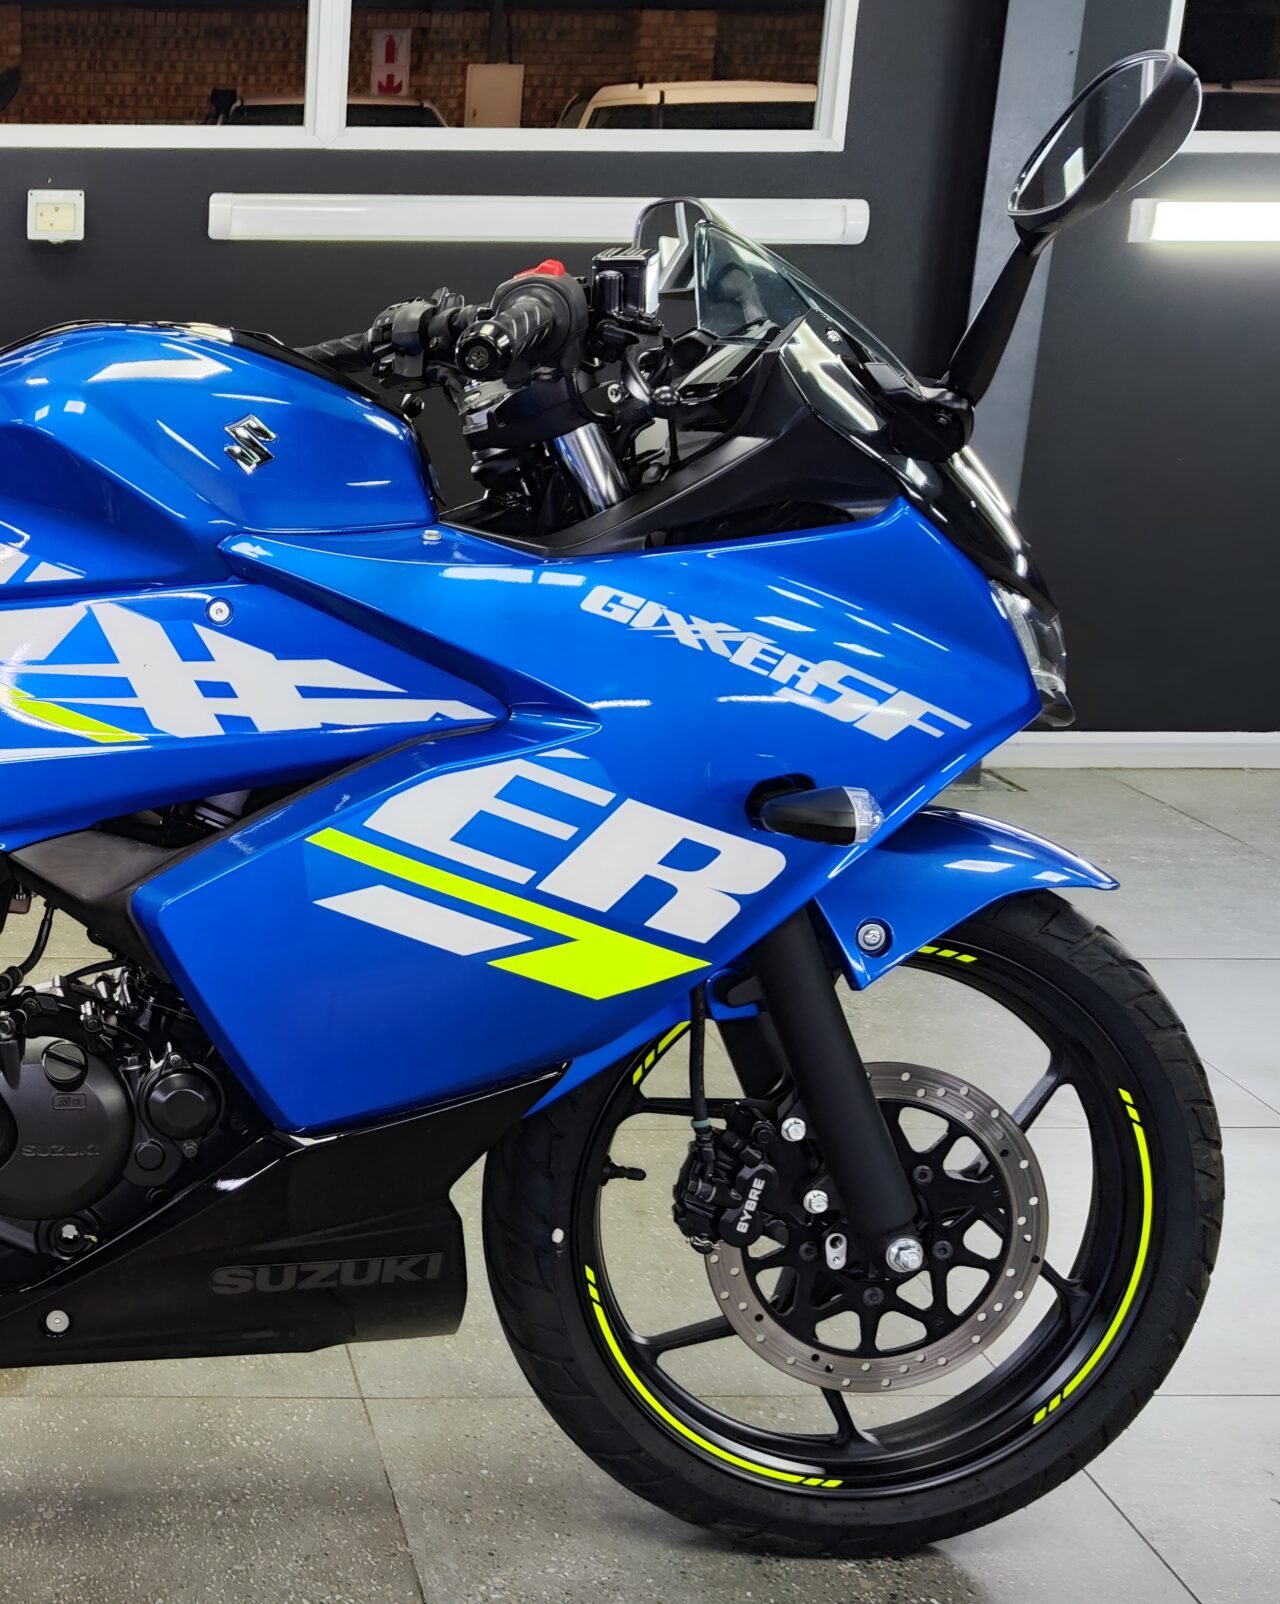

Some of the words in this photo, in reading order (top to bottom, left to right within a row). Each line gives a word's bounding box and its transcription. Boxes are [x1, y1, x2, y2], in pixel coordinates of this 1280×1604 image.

[21, 1143, 100, 1157] SUZUKI
[736, 1177, 766, 1234] BYBRE
[212, 1253, 444, 1295] SUZUKI
